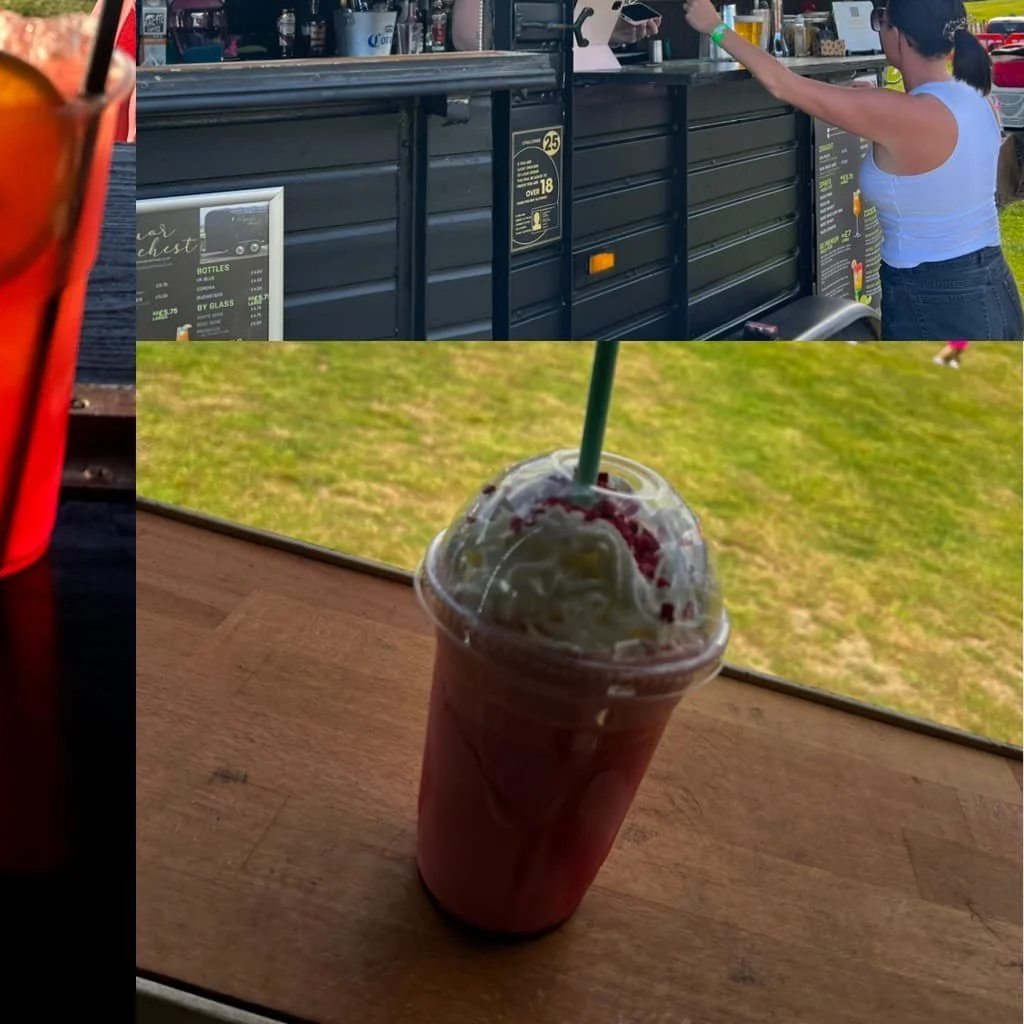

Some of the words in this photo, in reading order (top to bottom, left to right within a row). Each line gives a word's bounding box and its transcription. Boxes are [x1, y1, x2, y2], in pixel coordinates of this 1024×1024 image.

[544, 135, 559, 151] 25
[540, 177, 554, 194] 18
[137, 237, 199, 257] chest
[197, 265, 230, 275] BOTTLES
[197, 304, 208, 312] BY
[209, 299, 234, 308] GLASS
